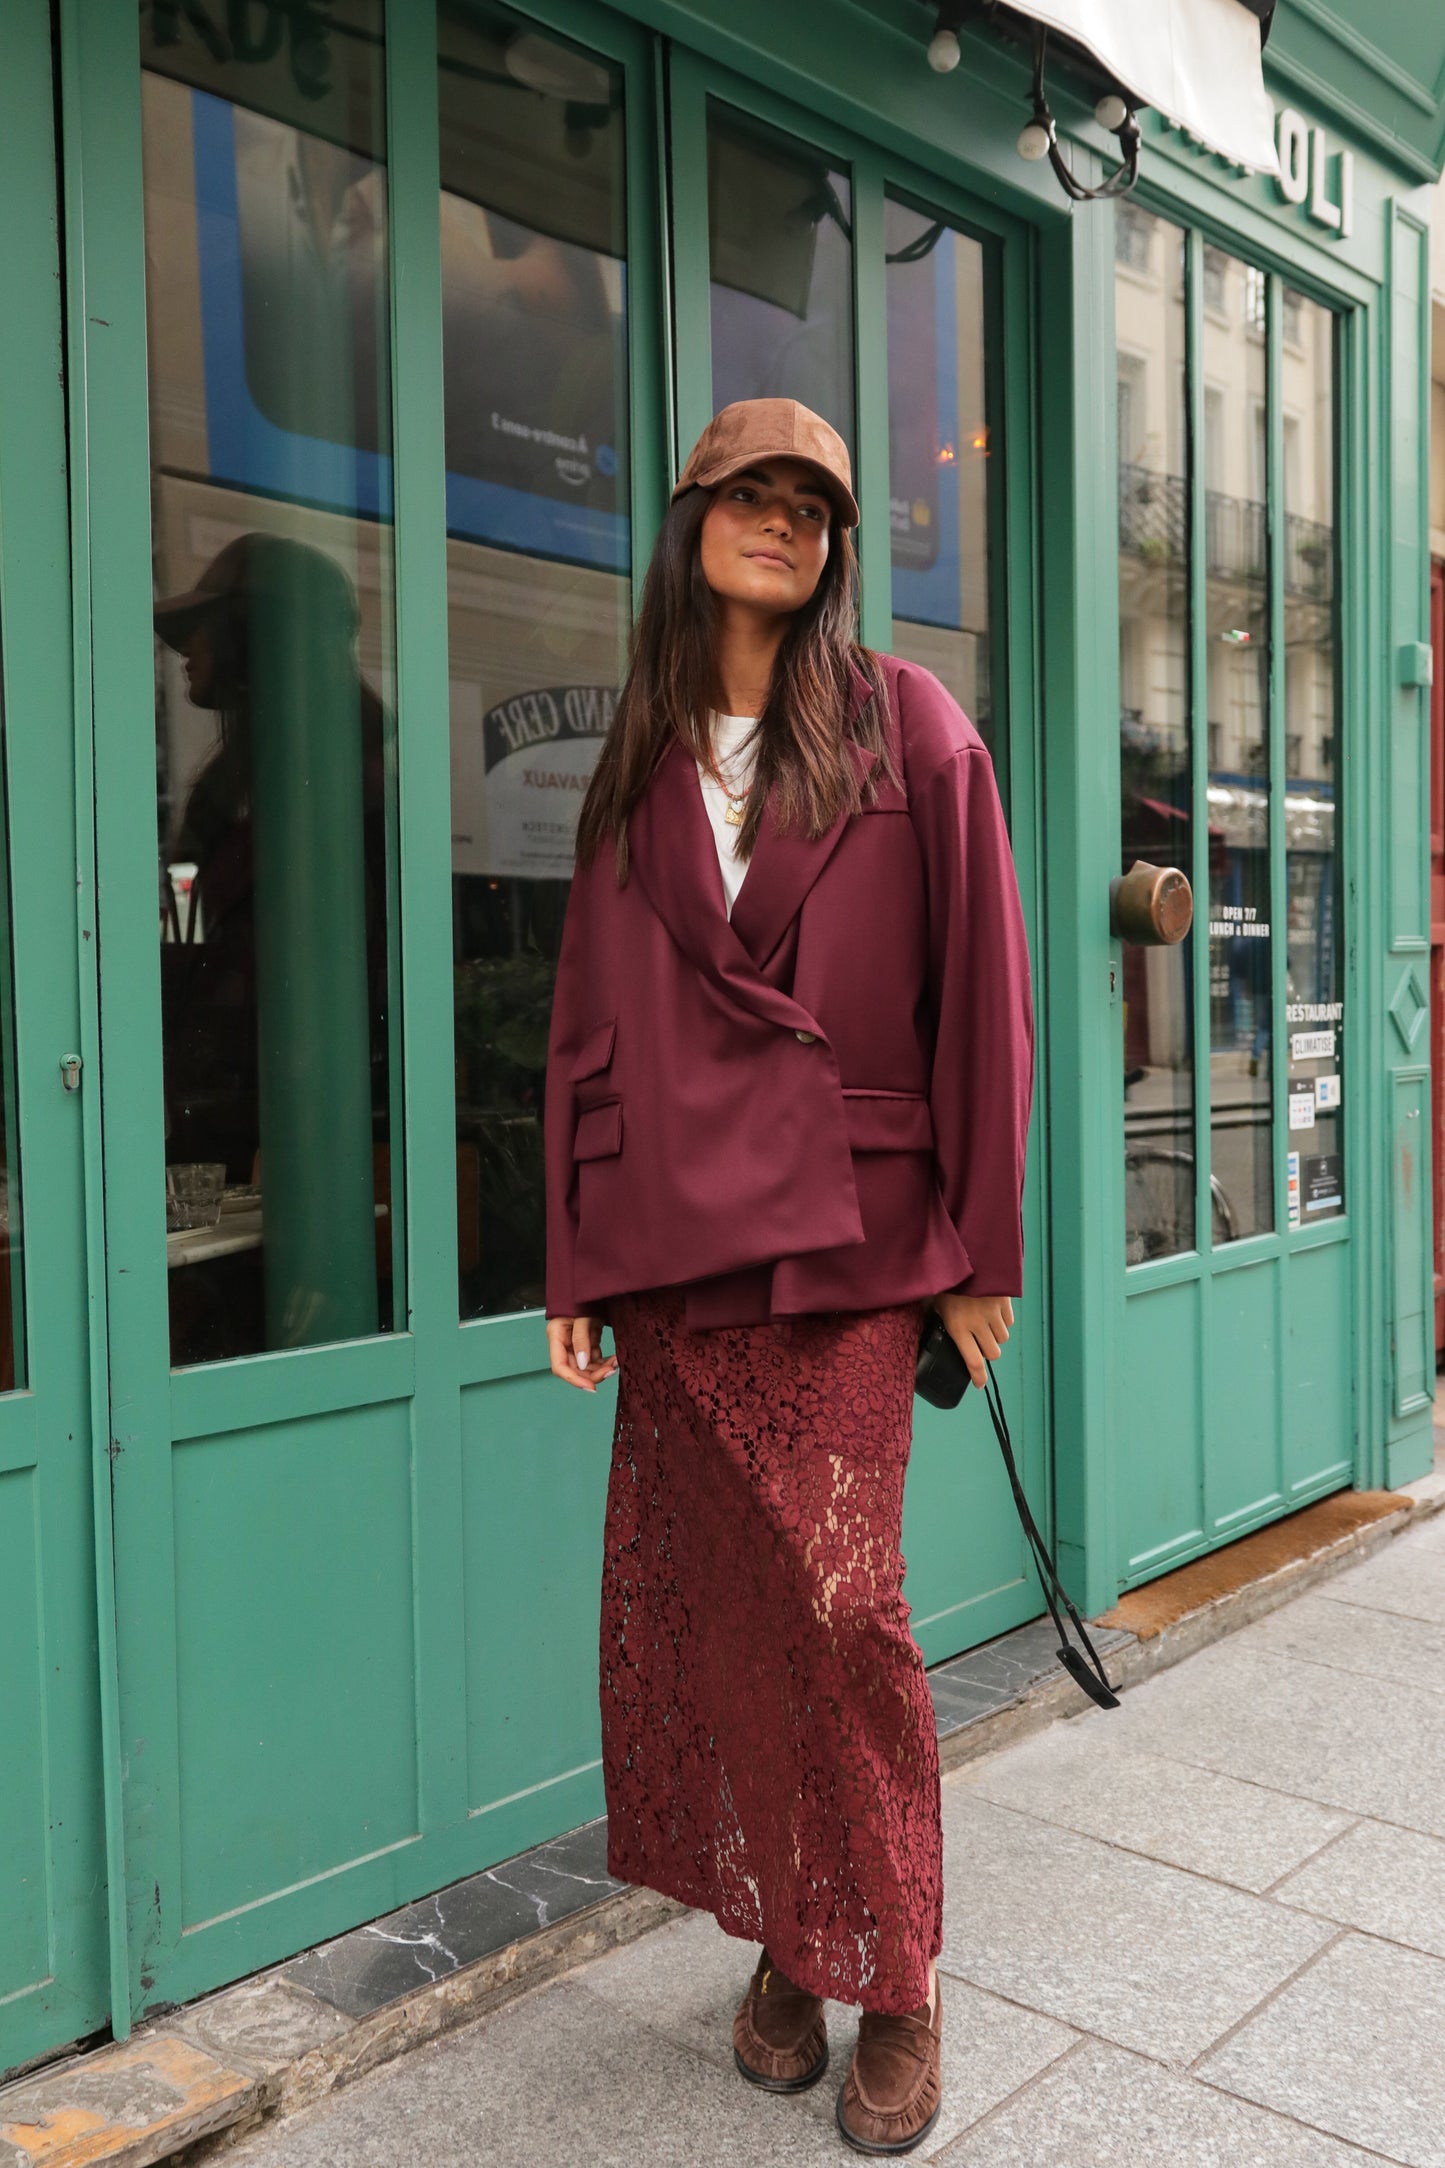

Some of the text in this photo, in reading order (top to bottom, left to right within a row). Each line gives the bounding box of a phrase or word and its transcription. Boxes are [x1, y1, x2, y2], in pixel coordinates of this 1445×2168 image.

[1223, 906, 1243, 920] OPEN
[1244, 907, 1257, 921] 7/7
[1209, 922, 1234, 936] LUNCH
[1242, 923, 1270, 937] DINNER
[1286, 1002, 1343, 1021] RESTAURANT
